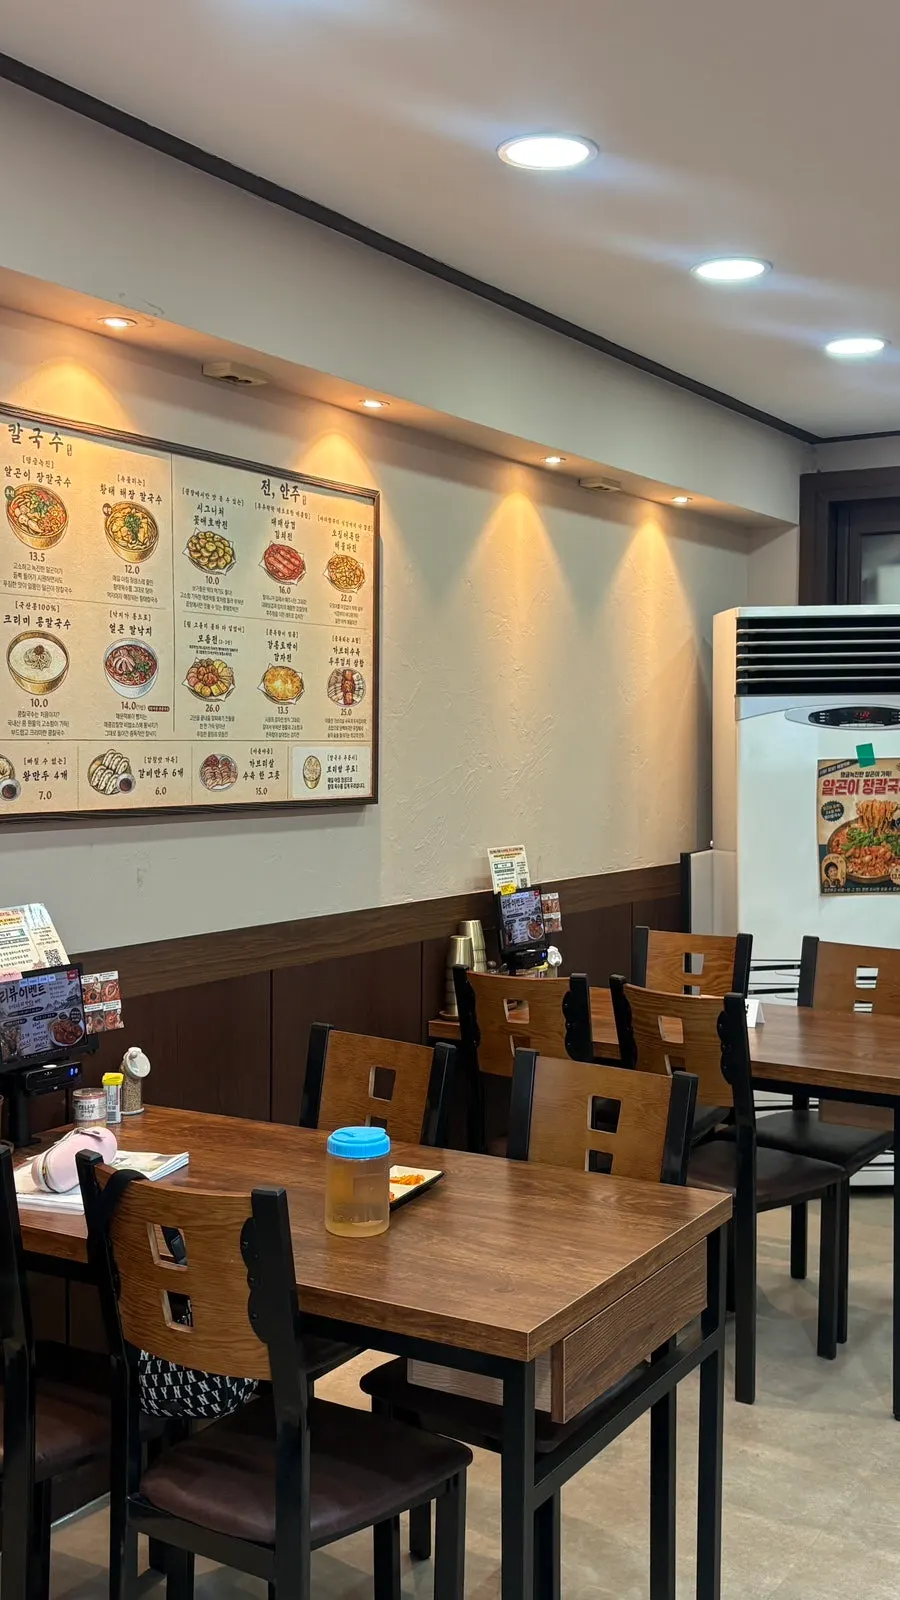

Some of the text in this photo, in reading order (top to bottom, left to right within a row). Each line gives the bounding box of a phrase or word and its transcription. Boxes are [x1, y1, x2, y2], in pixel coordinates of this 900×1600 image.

[8, 422, 64, 454] 칼국수
[4, 465, 72, 489] 알곤이 장칼국수
[99, 483, 163, 506] 황태 해장 칼국수
[261, 477, 275, 499] 전,
[280, 481, 300, 505] 안주
[197, 502, 224, 517] 시그니처
[274, 529, 293, 542] 김치전
[29, 551, 45, 562] 13.5
[125, 565, 140, 575] 12.0
[205, 576, 220, 585] 10.0
[279, 586, 291, 595] 16.0
[341, 594, 352, 603] 22.0
[3, 613, 71, 630] 크리미 콩칼국수
[109, 623, 152, 637] 얼큰 칼낙지
[30, 699, 49, 707] 10.0
[205, 704, 220, 712] 26.0
[277, 706, 289, 714] 13.5
[341, 708, 352, 716] 25.0
[42, 757, 48, 765] 수
[249, 759, 275, 769] 가브리살
[22, 769, 67, 782] 왕만두 4개
[138, 767, 184, 779] 갈비만두 6개
[242, 770, 280, 781] 수육 한 그릇
[155, 787, 167, 795] 6.0
[256, 787, 268, 795] 15.0
[822, 778, 900, 796] 알곤이 장칼국
[38, 791, 52, 800] 7.0
